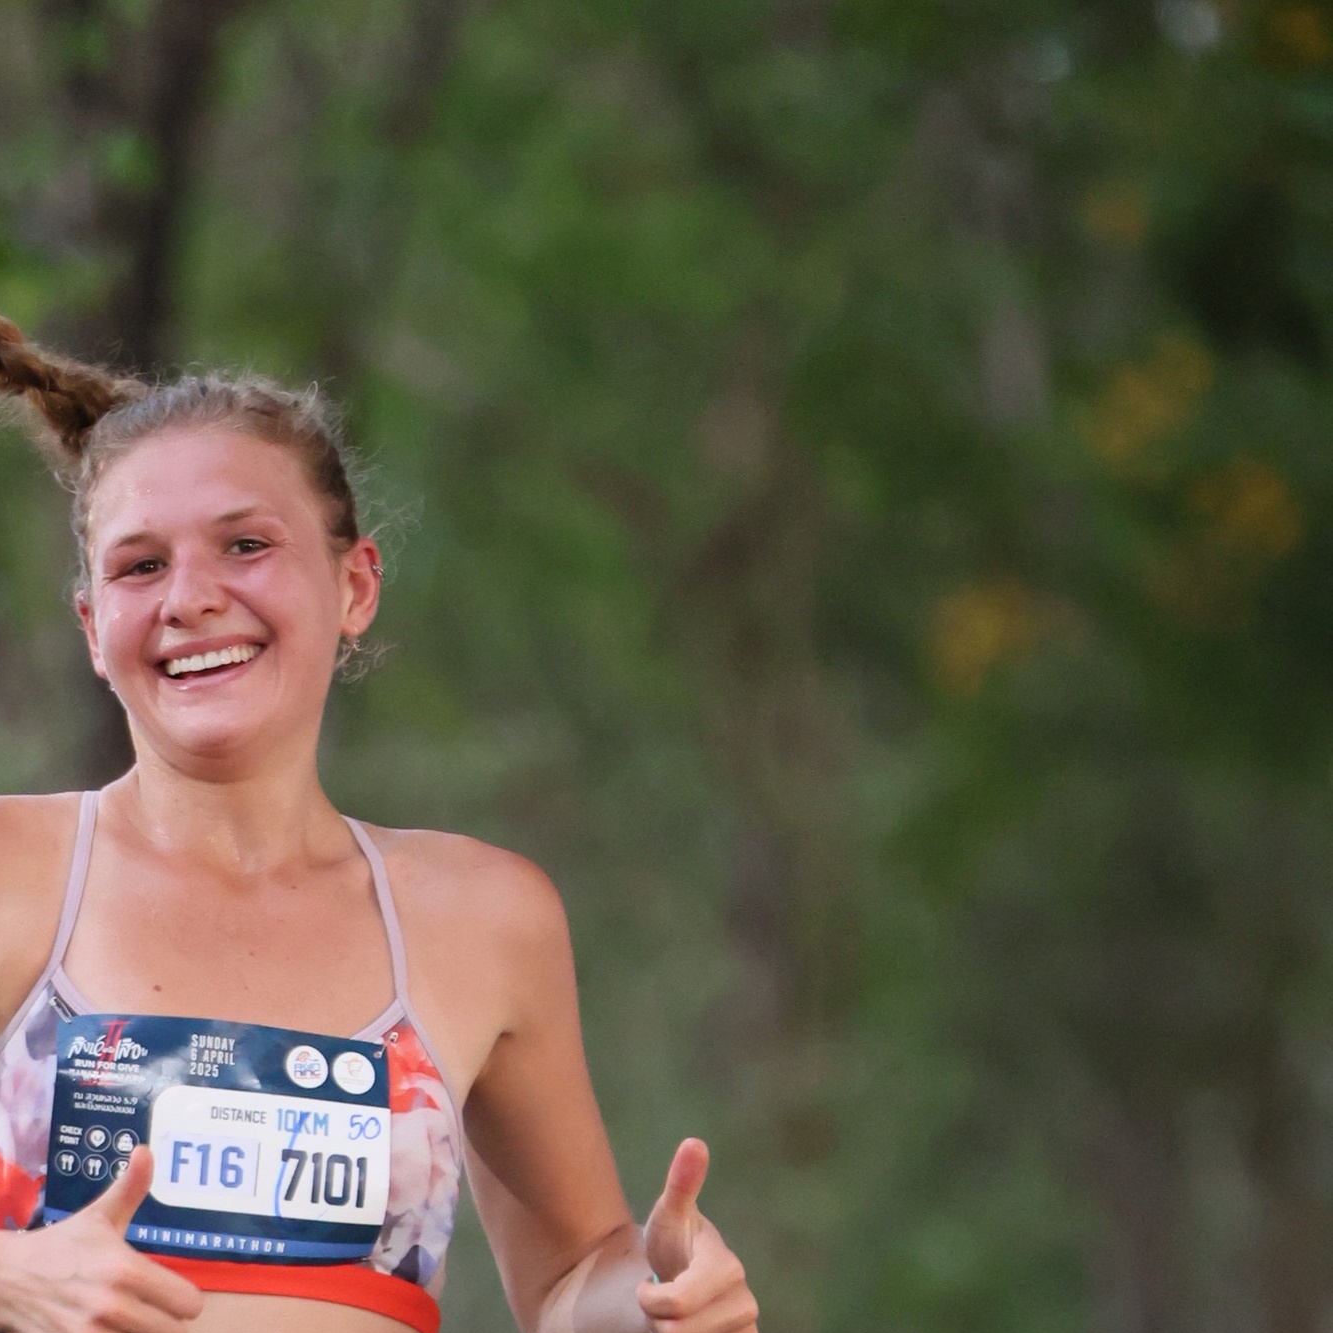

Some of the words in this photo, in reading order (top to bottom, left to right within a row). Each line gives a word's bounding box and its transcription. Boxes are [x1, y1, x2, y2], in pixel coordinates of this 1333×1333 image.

[191, 1034, 236, 1052] SUNDAY
[75, 1059, 96, 1069] RUN
[97, 1062, 117, 1072] FOR
[118, 1064, 141, 1074] GIVE
[190, 1049, 198, 1062] 6
[203, 1051, 236, 1066] APRIL
[190, 1063, 219, 1078] 2025
[210, 1106, 267, 1124] DISTANCE
[277, 1108, 329, 1136] 10KM
[60, 1126, 84, 1136] CHECK
[348, 1114, 382, 1140] 50
[59, 1136, 80, 1146] POINT
[170, 1140, 245, 1189] F16
[281, 1148, 368, 1208] 7101
[137, 1227, 286, 1254] MINIMARATHON
